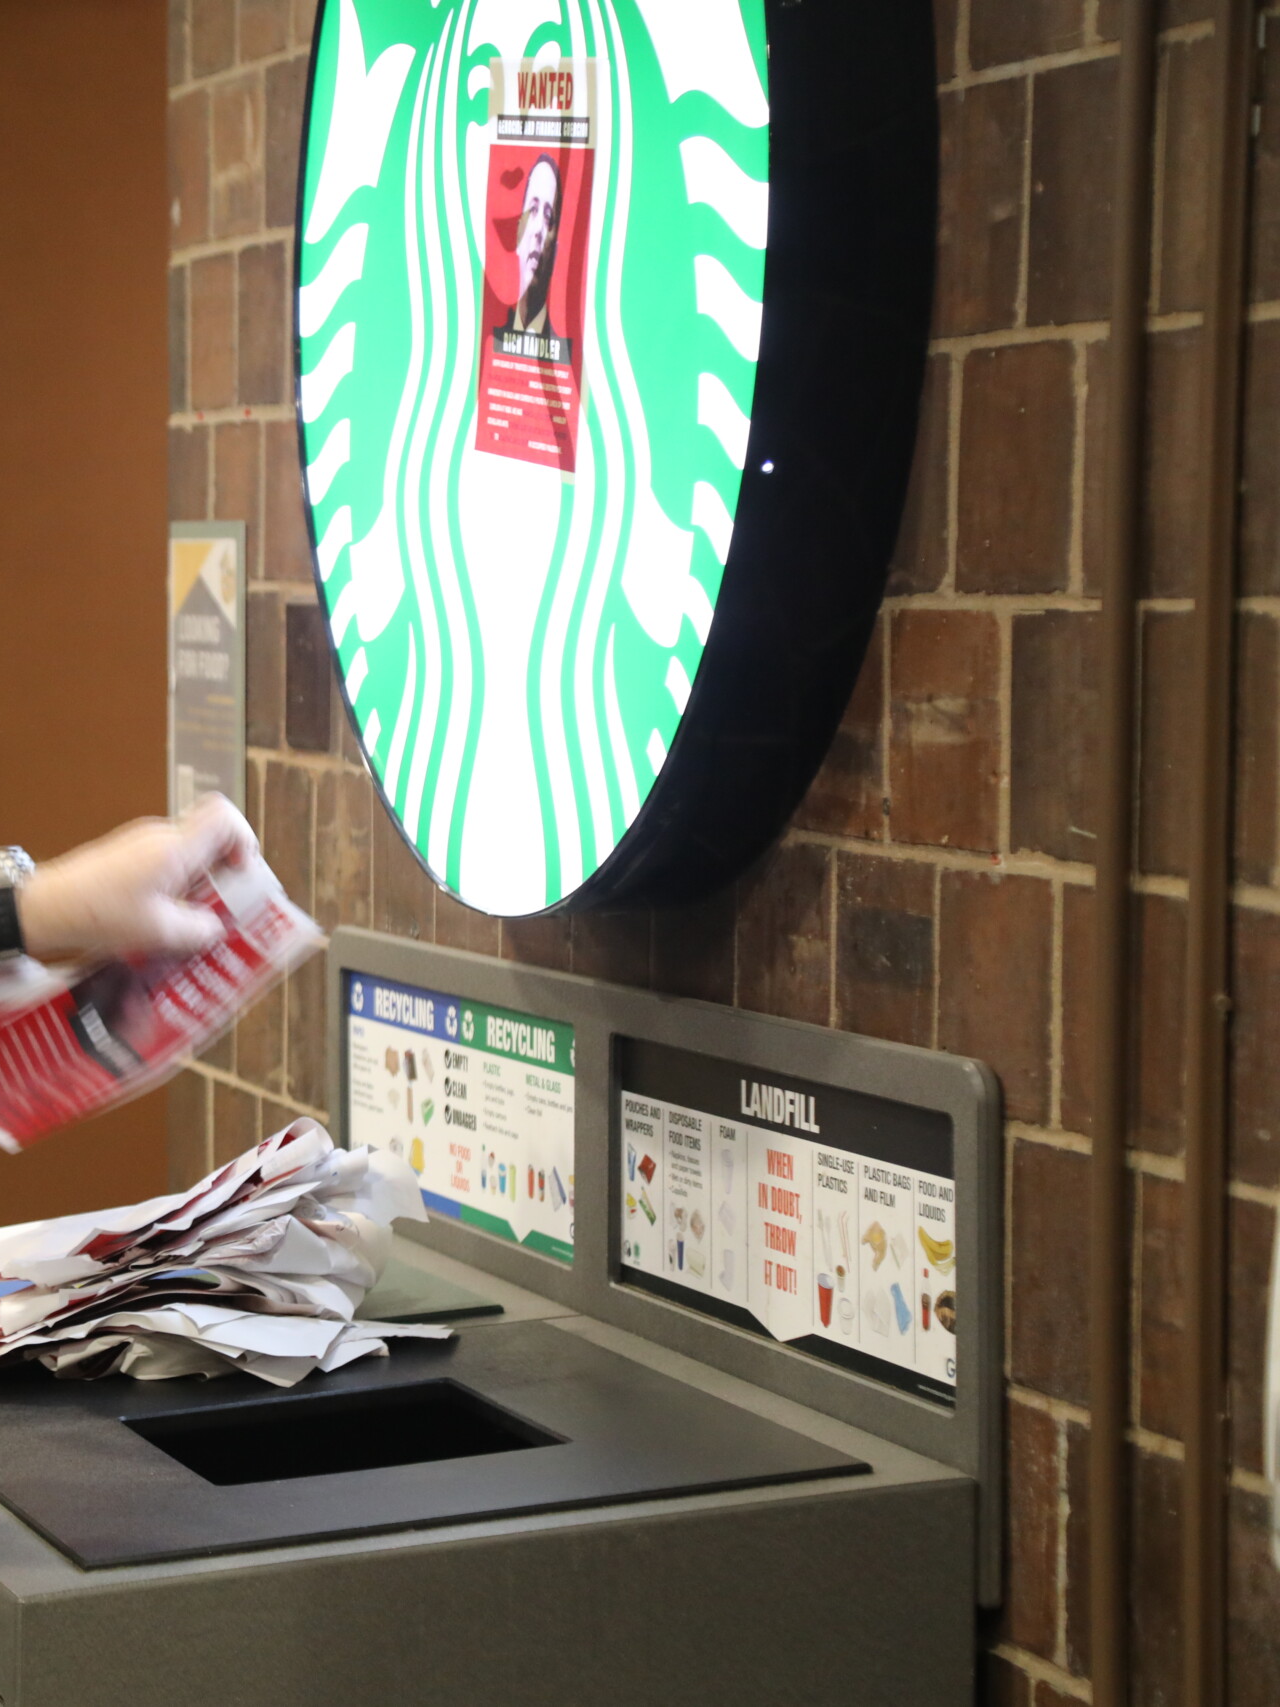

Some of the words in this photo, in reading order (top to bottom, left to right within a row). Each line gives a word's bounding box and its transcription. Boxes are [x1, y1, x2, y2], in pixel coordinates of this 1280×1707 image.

[517, 72, 573, 110] WANTED
[503, 332, 522, 354] RICH
[523, 335, 560, 361] HANDLER
[374, 986, 435, 1031] RECYCLING
[486, 1015, 556, 1063] RECYCLING
[452, 1052, 469, 1072] EMPTY
[625, 1099, 649, 1117] POUCHES
[650, 1105, 661, 1120] AND
[741, 1079, 820, 1134] LANDFILL
[625, 1118, 654, 1138] WRAPPERS
[669, 1111, 702, 1132] DISPOSABLE
[720, 1124, 736, 1141] FOAM
[669, 1130, 683, 1146] FOOD
[684, 1135, 702, 1151] ITEMS
[766, 1148, 794, 1181] WHEN
[818, 1152, 855, 1175] SINGLE-USE
[818, 1173, 848, 1194] PLASTICS
[864, 1165, 892, 1185] PLASTIC
[892, 1173, 912, 1191] BAGS
[758, 1182, 769, 1210] IN
[771, 1186, 803, 1224] DOUBT,
[864, 1187, 879, 1203] AND
[880, 1191, 896, 1208] FILM
[919, 1180, 937, 1198] FOOD
[939, 1186, 954, 1203] AND
[919, 1202, 946, 1223] LIQUIDS
[764, 1221, 797, 1257] THROW
[764, 1259, 773, 1287] IT
[776, 1263, 798, 1295] OUT!
